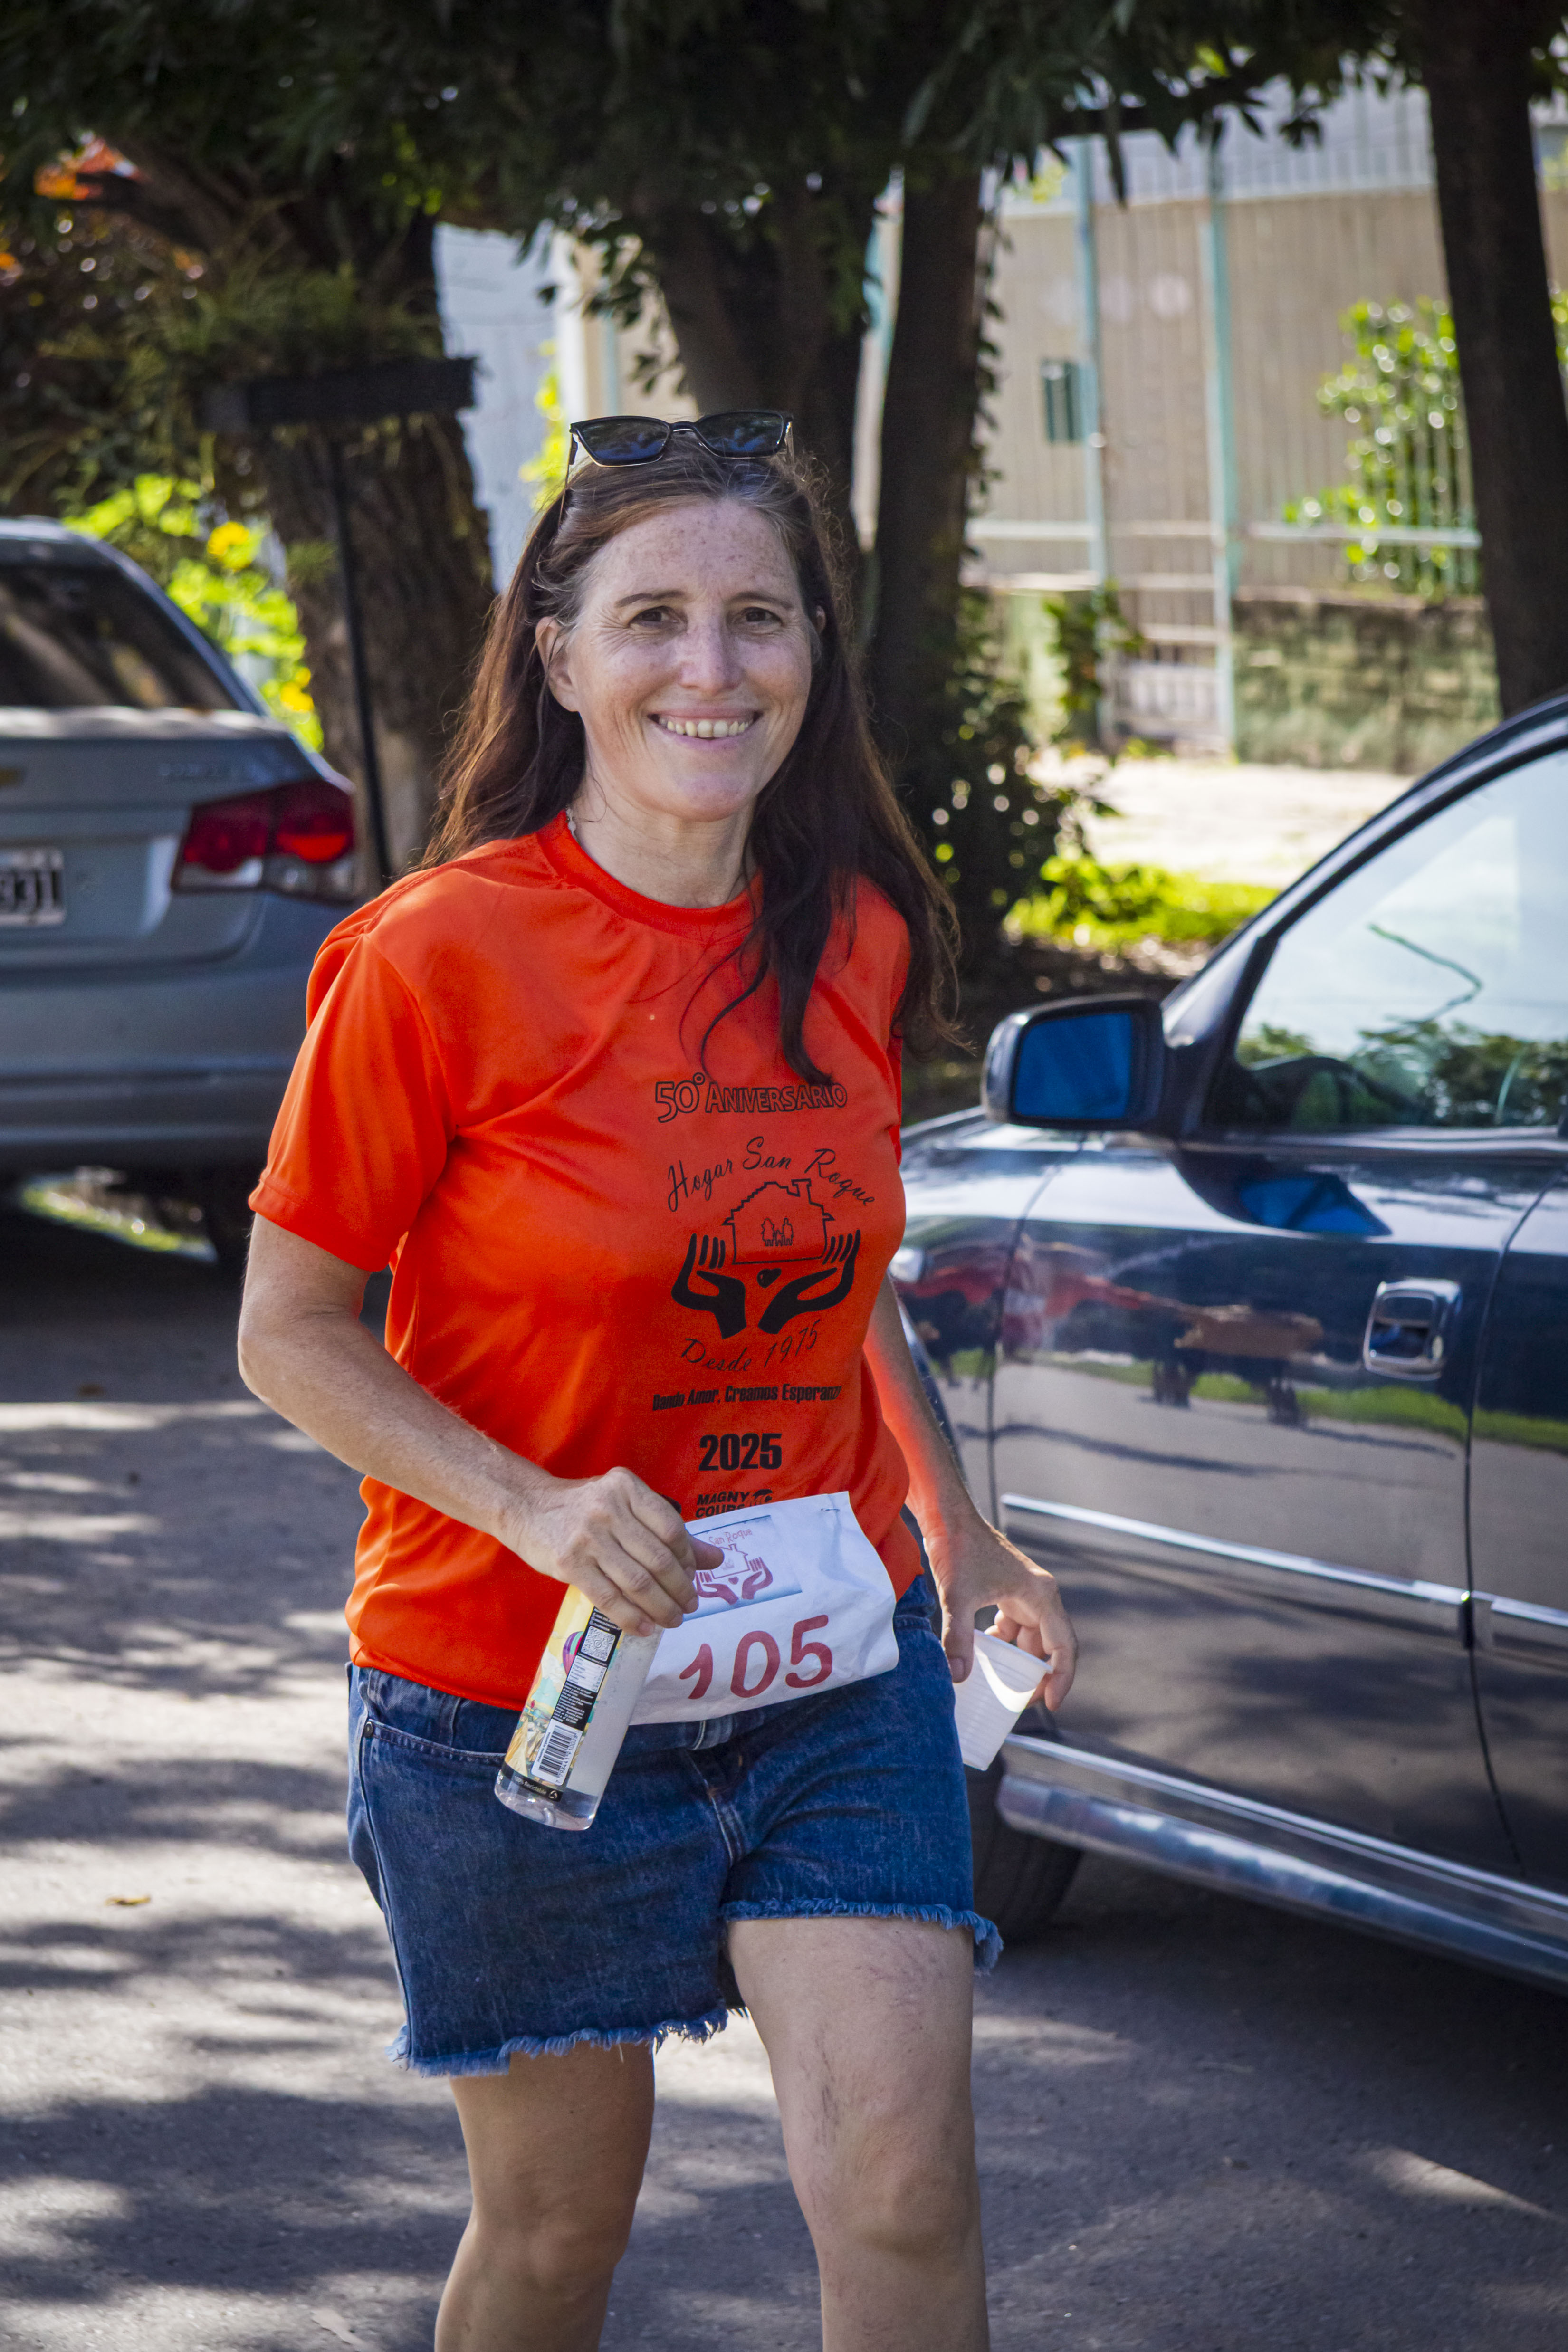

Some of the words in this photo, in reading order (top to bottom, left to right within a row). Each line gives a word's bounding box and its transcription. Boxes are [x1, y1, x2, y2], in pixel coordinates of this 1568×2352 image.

[705, 1082, 847, 1113] ANIVERSARIO
[668, 1159, 732, 1212] Hogar
[743, 1136, 791, 1170] San
[804, 1148, 875, 1206] Roque
[681, 1338, 752, 1371] Desde
[764, 1319, 820, 1367] 1975
[652, 1392, 685, 1411] Dando
[687, 1389, 721, 1405] Amor,
[725, 1385, 778, 1402] Creamos
[698, 1433, 782, 1471] 2025
[697, 1491, 750, 1505] MAGNY
[709, 1536, 725, 1545] San
[725, 1529, 753, 1544] Roque
[679, 1615, 832, 1699] 105
